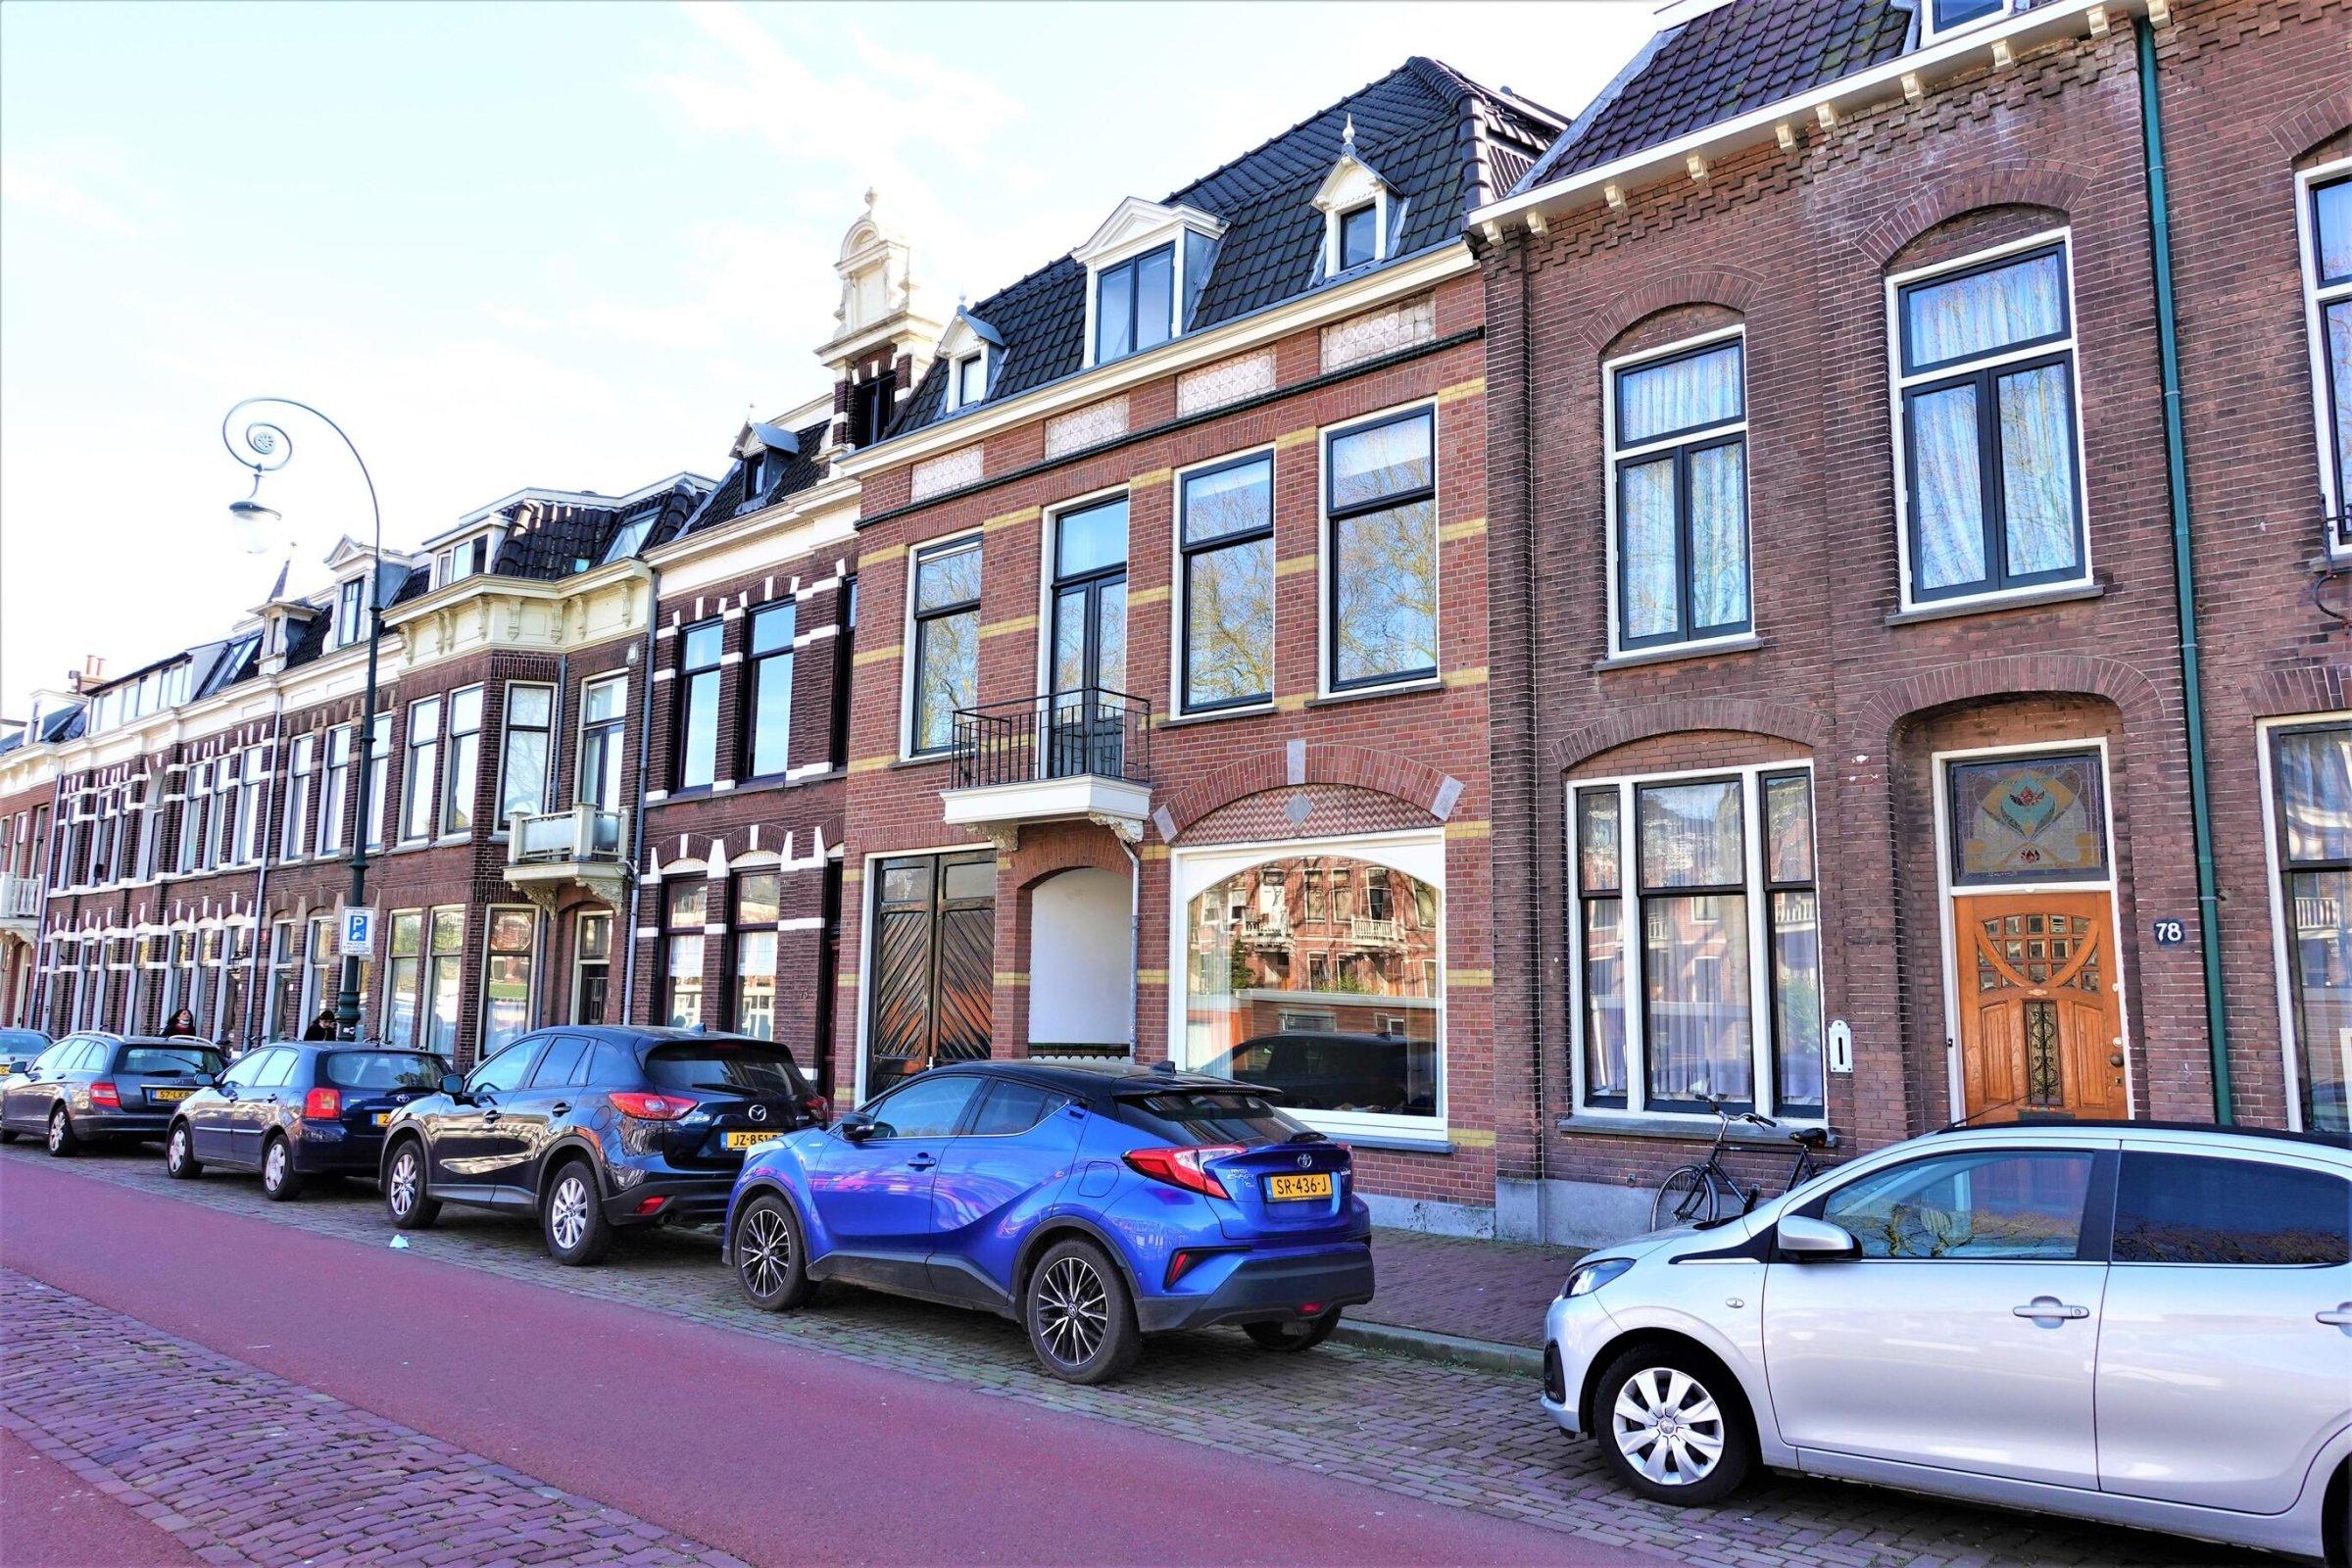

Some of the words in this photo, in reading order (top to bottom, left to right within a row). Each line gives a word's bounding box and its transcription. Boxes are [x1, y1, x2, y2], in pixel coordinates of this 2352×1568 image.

[353, 916, 365, 931] P
[2156, 922, 2182, 941] 78
[1276, 1177, 1327, 1195] SR-436-J
